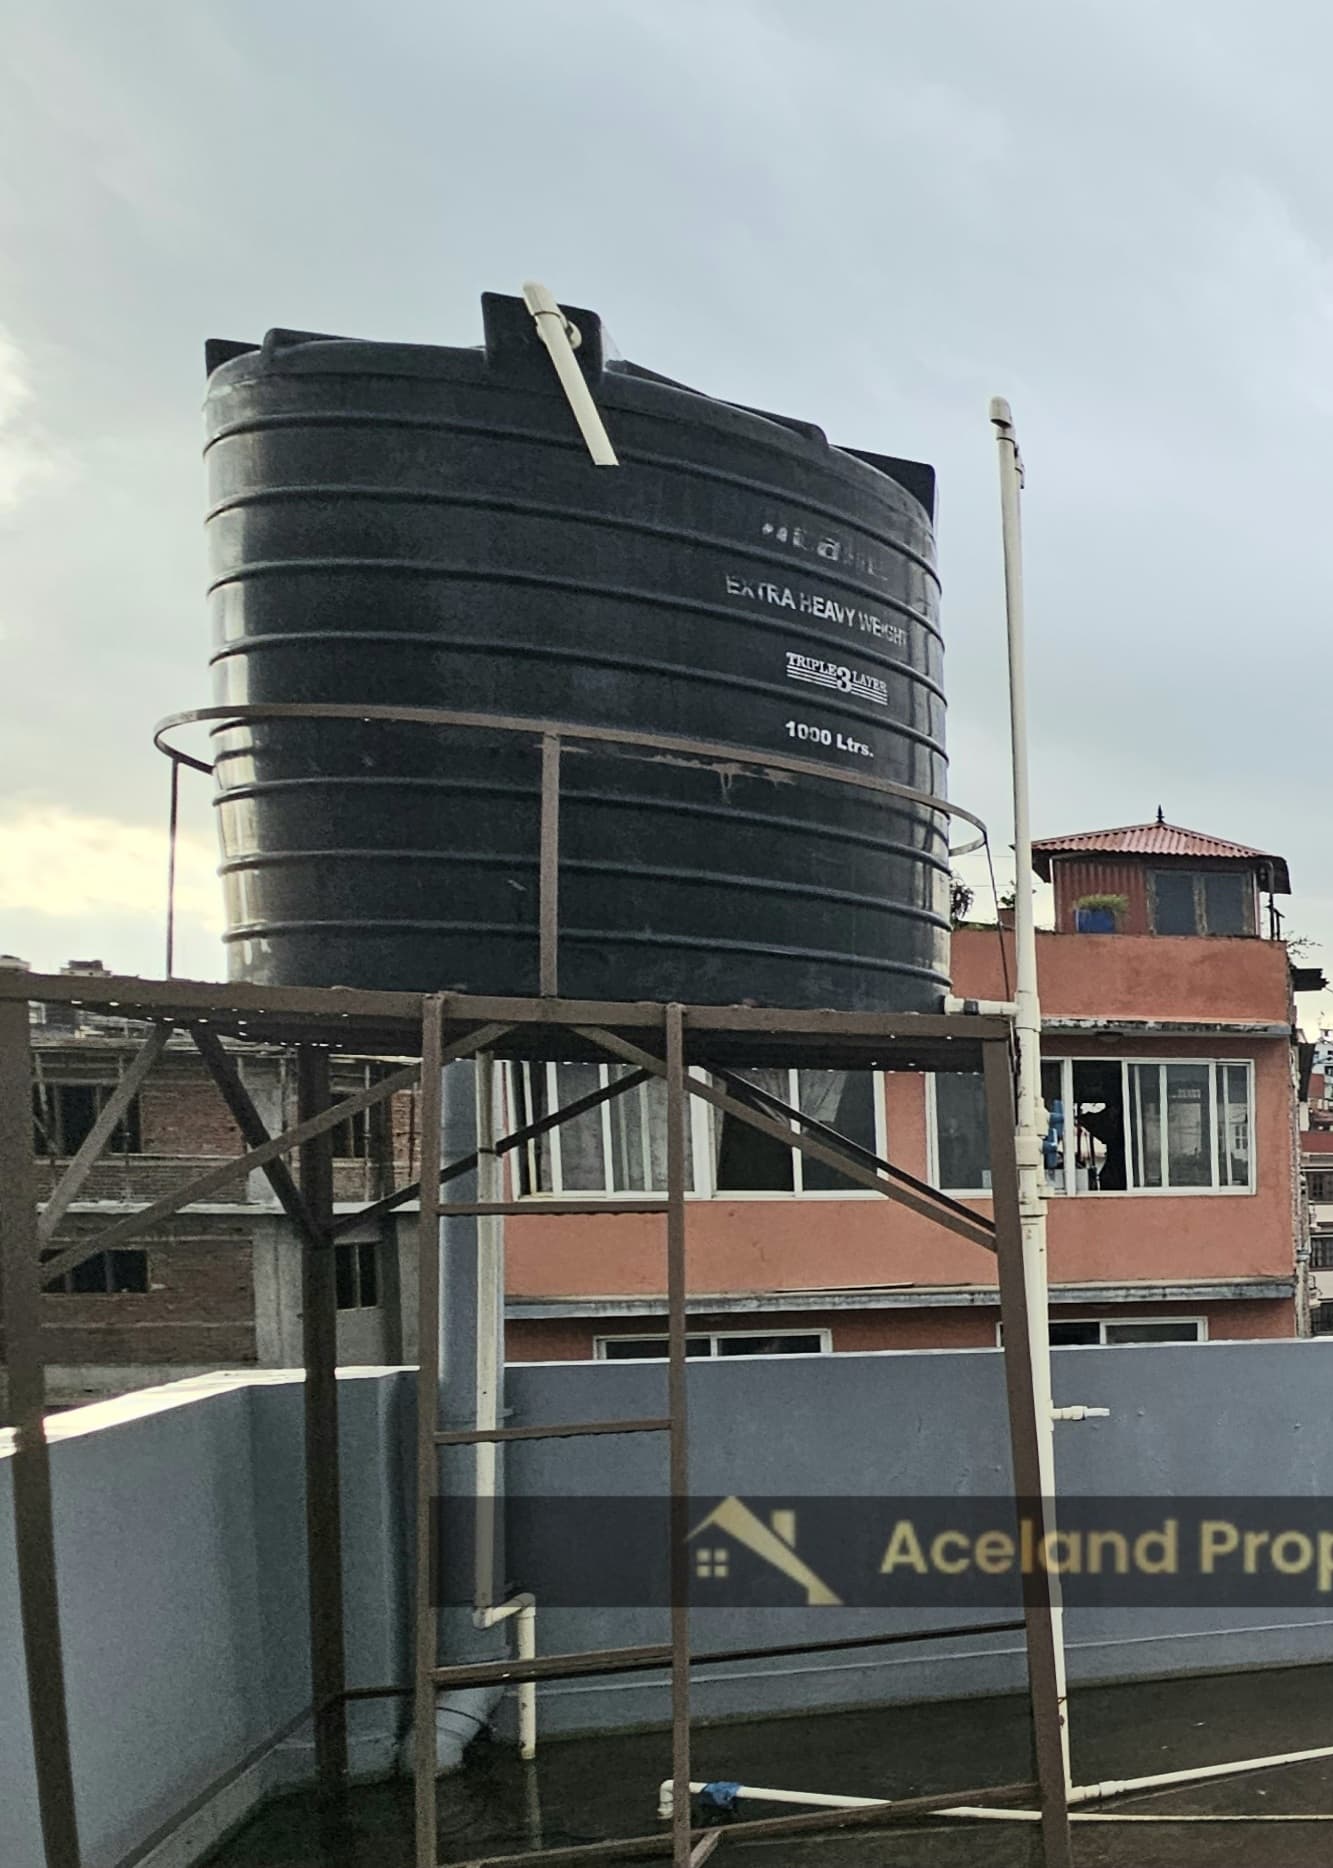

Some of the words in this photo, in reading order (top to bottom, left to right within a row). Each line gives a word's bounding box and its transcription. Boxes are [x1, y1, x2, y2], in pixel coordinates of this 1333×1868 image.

[726, 575, 796, 610] EXTRA
[801, 593, 855, 627] HEAVY
[785, 652, 837, 677] TRIPLE
[836, 667, 852, 693] 3
[853, 671, 888, 693] LAYER
[785, 720, 832, 746] 1000
[836, 734, 874, 757] Ltrs.
